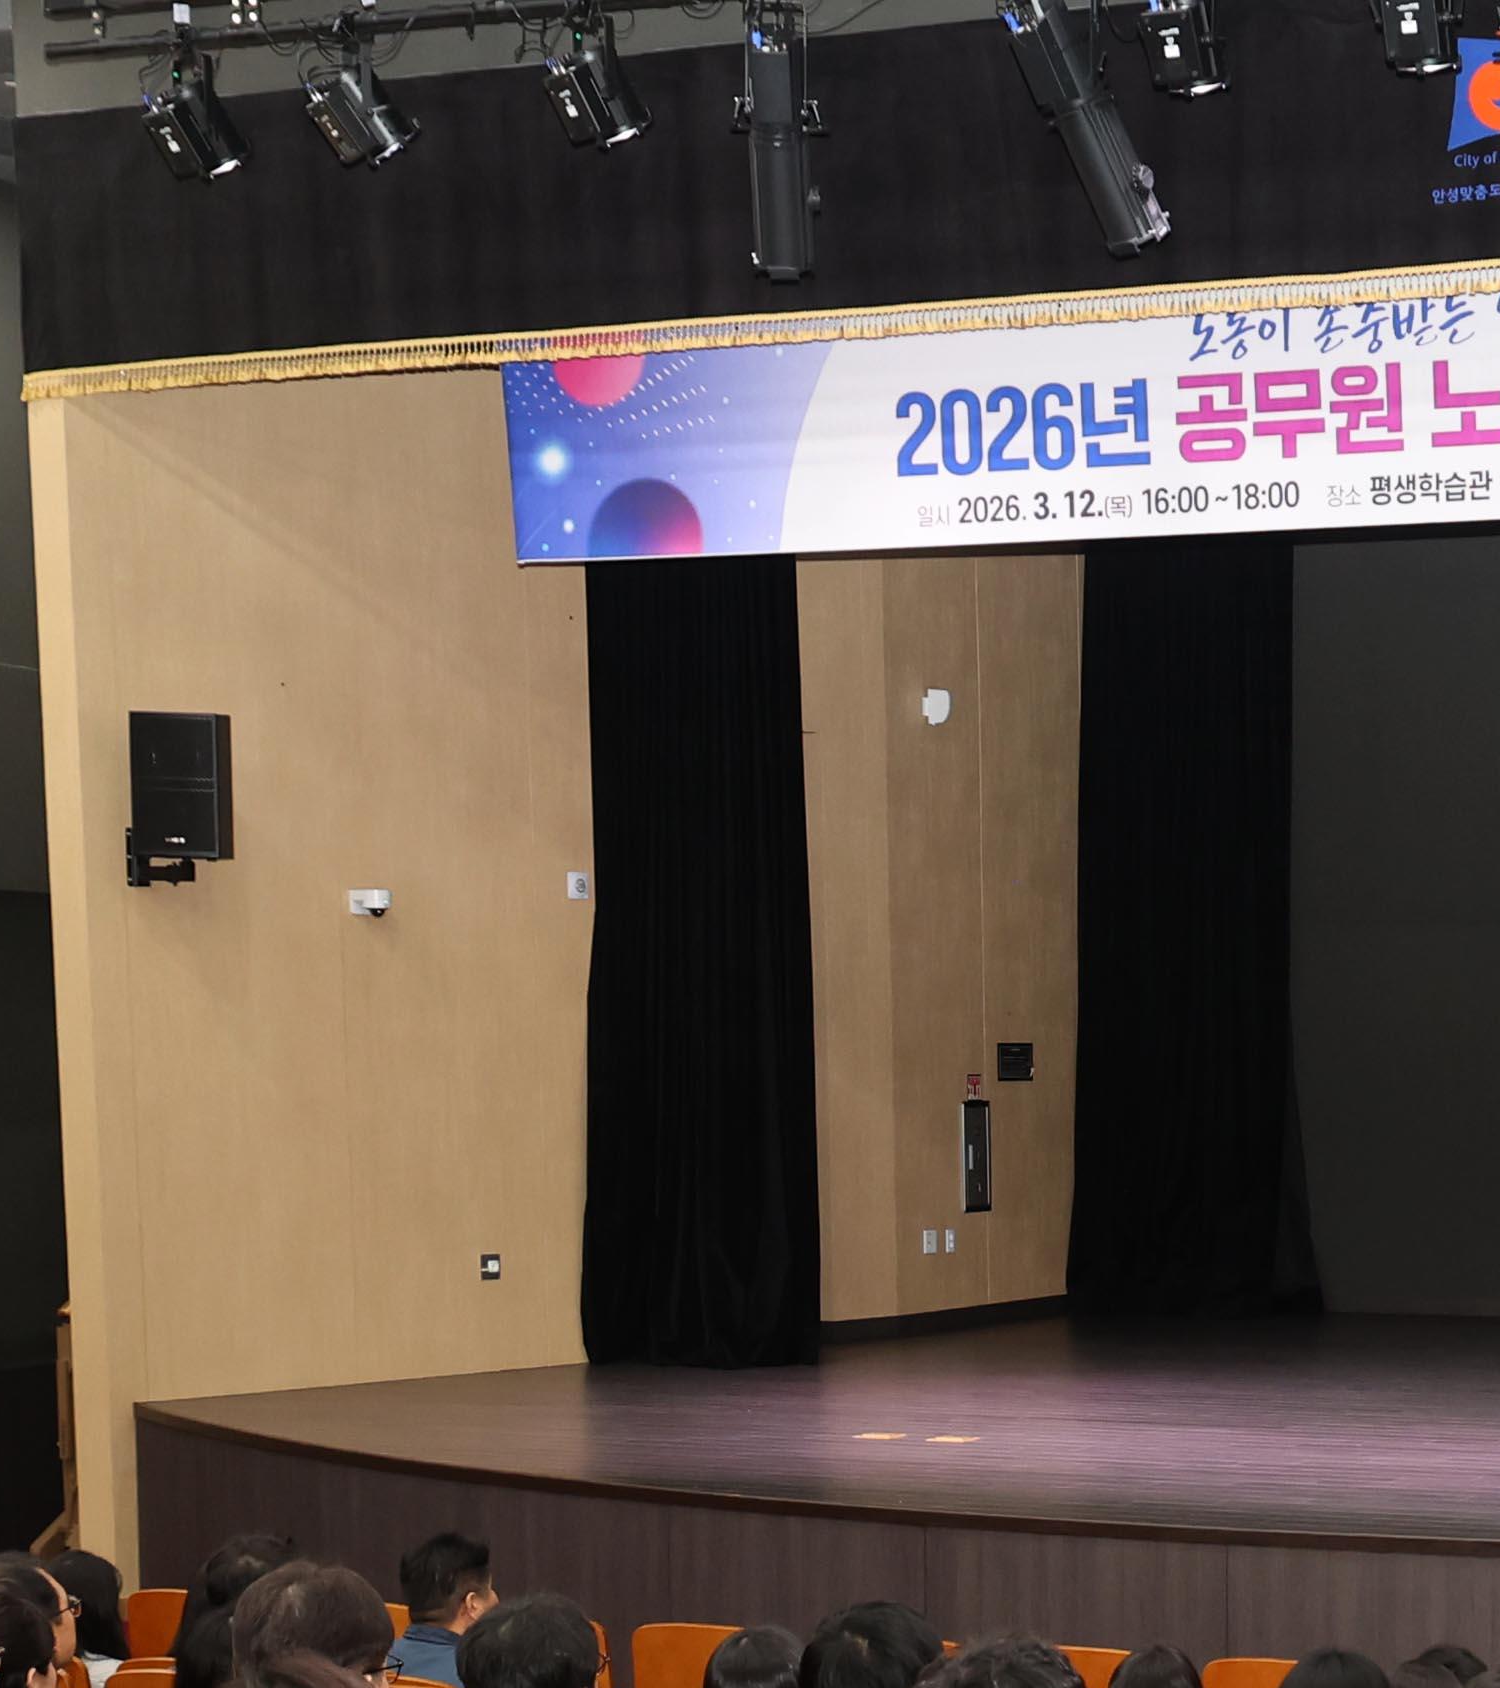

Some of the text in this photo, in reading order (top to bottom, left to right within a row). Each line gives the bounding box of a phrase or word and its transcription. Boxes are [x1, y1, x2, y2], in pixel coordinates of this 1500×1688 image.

[1453, 153, 1479, 168] City
[1483, 151, 1497, 164] of
[896, 378, 1151, 477] 2026년
[1175, 362, 1404, 463] 공무원
[917, 504, 951, 528] 일시
[958, 496, 1027, 524] 2026.
[1326, 483, 1362, 508] 장소
[1369, 470, 1493, 506] 평생학습관
